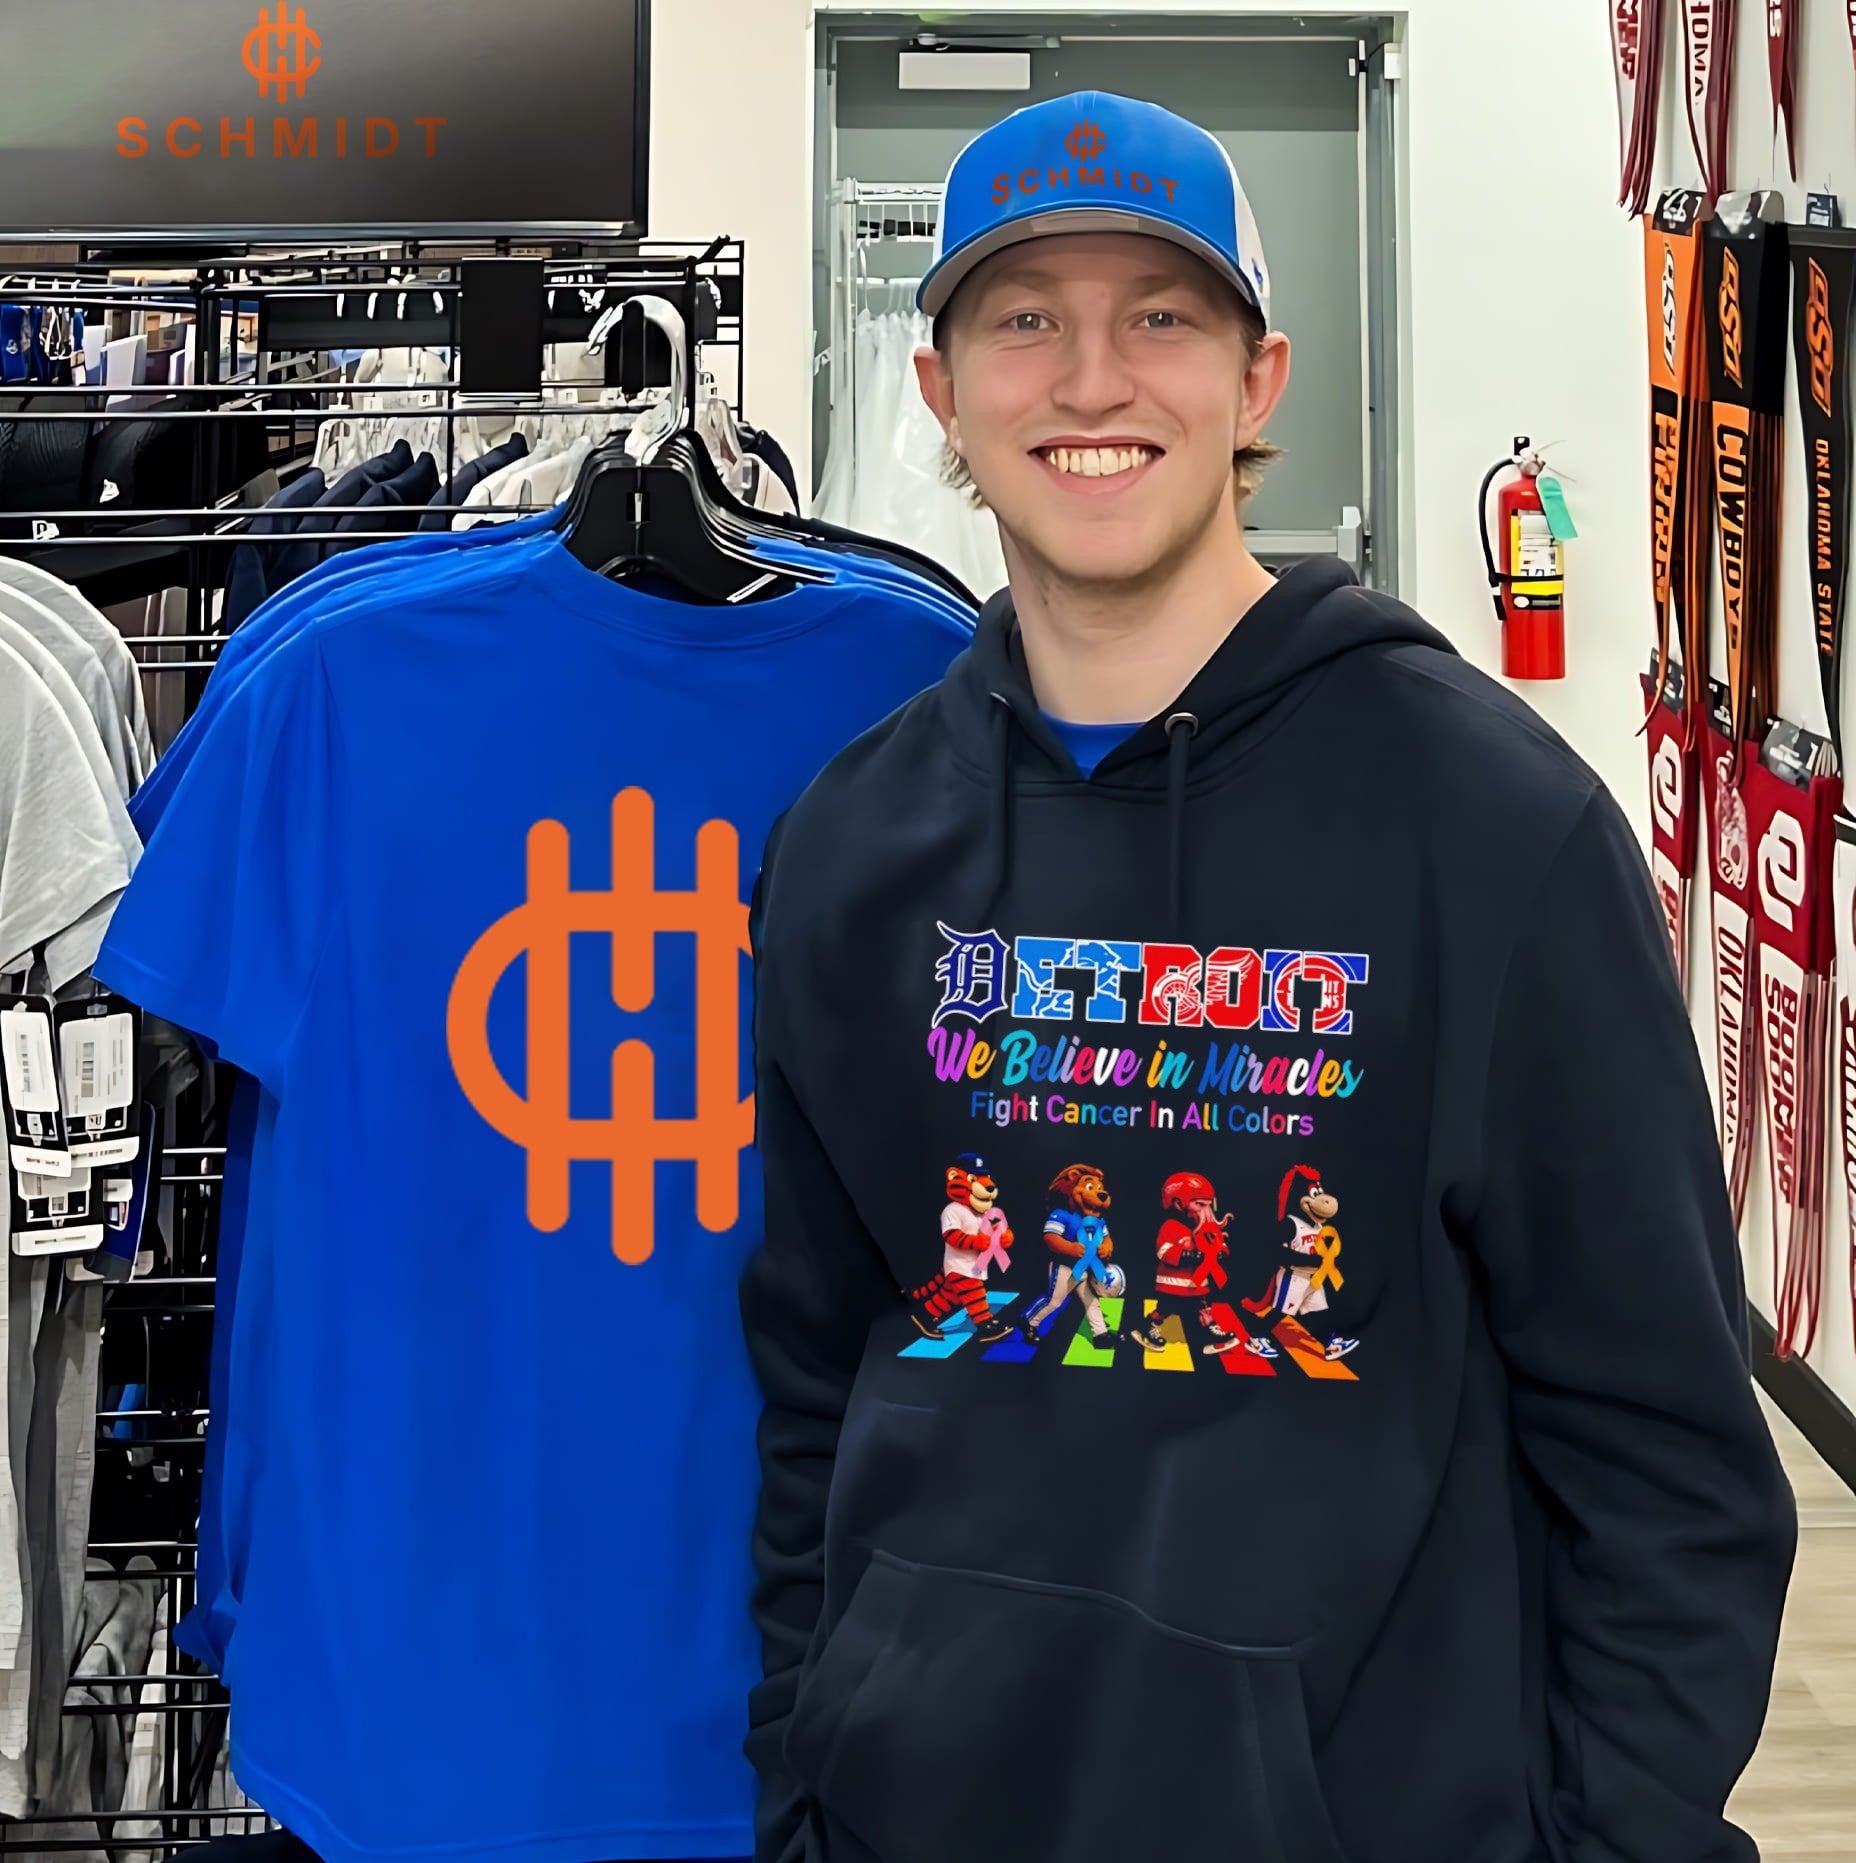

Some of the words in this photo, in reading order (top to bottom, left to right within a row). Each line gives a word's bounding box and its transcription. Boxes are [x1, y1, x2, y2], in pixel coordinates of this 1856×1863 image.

[116, 115, 448, 159] SCHMIDT
[991, 166, 1180, 205] SCHMIDT
[930, 920, 1370, 1036] DETROIT
[926, 1025, 997, 1083] We
[1000, 1029, 1143, 1089] Believe
[1146, 1039, 1195, 1090] in
[1197, 1039, 1365, 1100] Miracles
[1717, 926, 1746, 1144] OKLAHOMA
[971, 1090, 1039, 1127] Fight
[1045, 1094, 1142, 1128] Cancer
[1149, 1100, 1174, 1129] In
[1181, 1101, 1219, 1131] All
[1227, 1104, 1314, 1136] Colors
